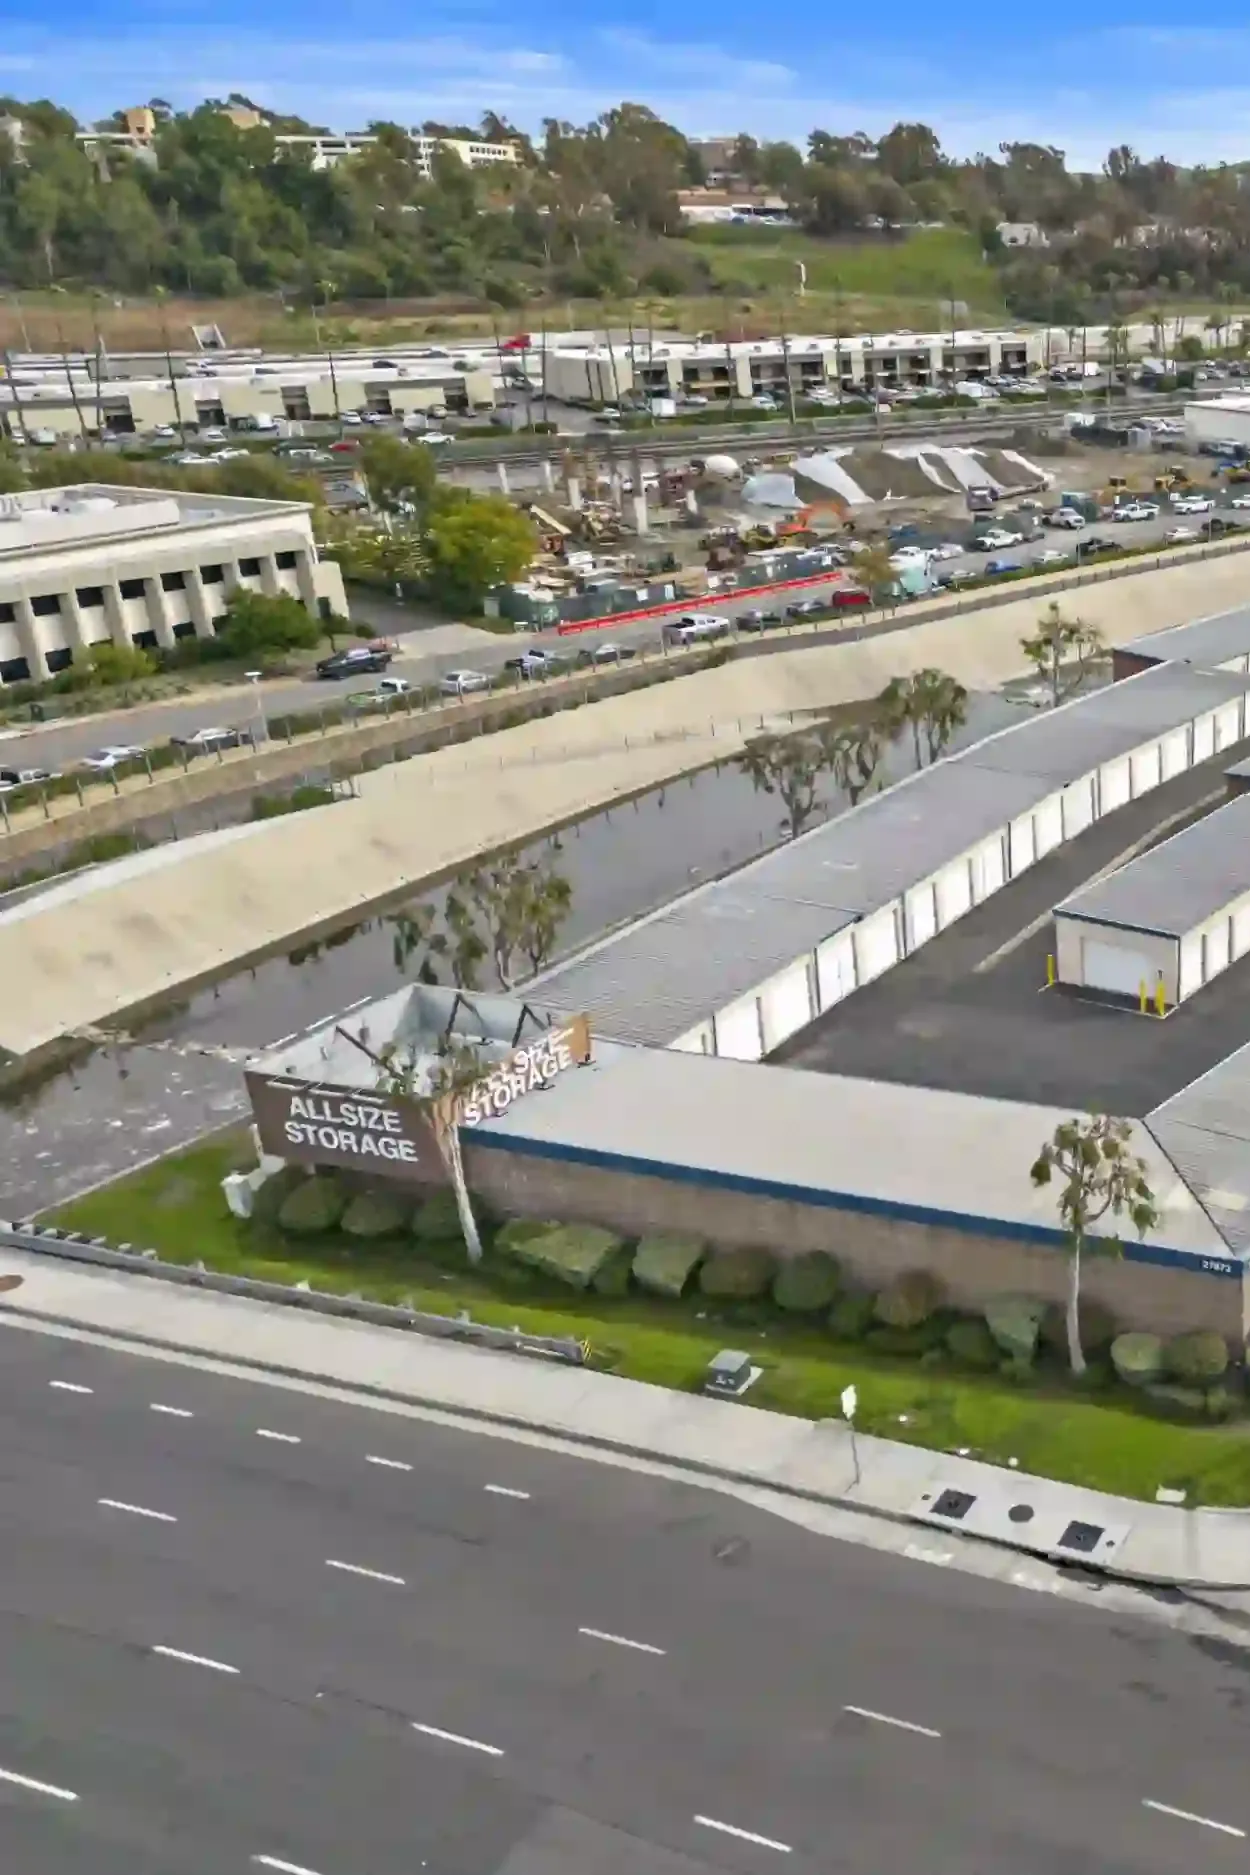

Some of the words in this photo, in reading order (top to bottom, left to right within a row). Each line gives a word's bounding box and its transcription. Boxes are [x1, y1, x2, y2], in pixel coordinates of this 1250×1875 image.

[464, 1046, 573, 1126] STORAGE
[290, 1096, 402, 1132] ALLSIZE
[284, 1120, 419, 1162] STORAGE
